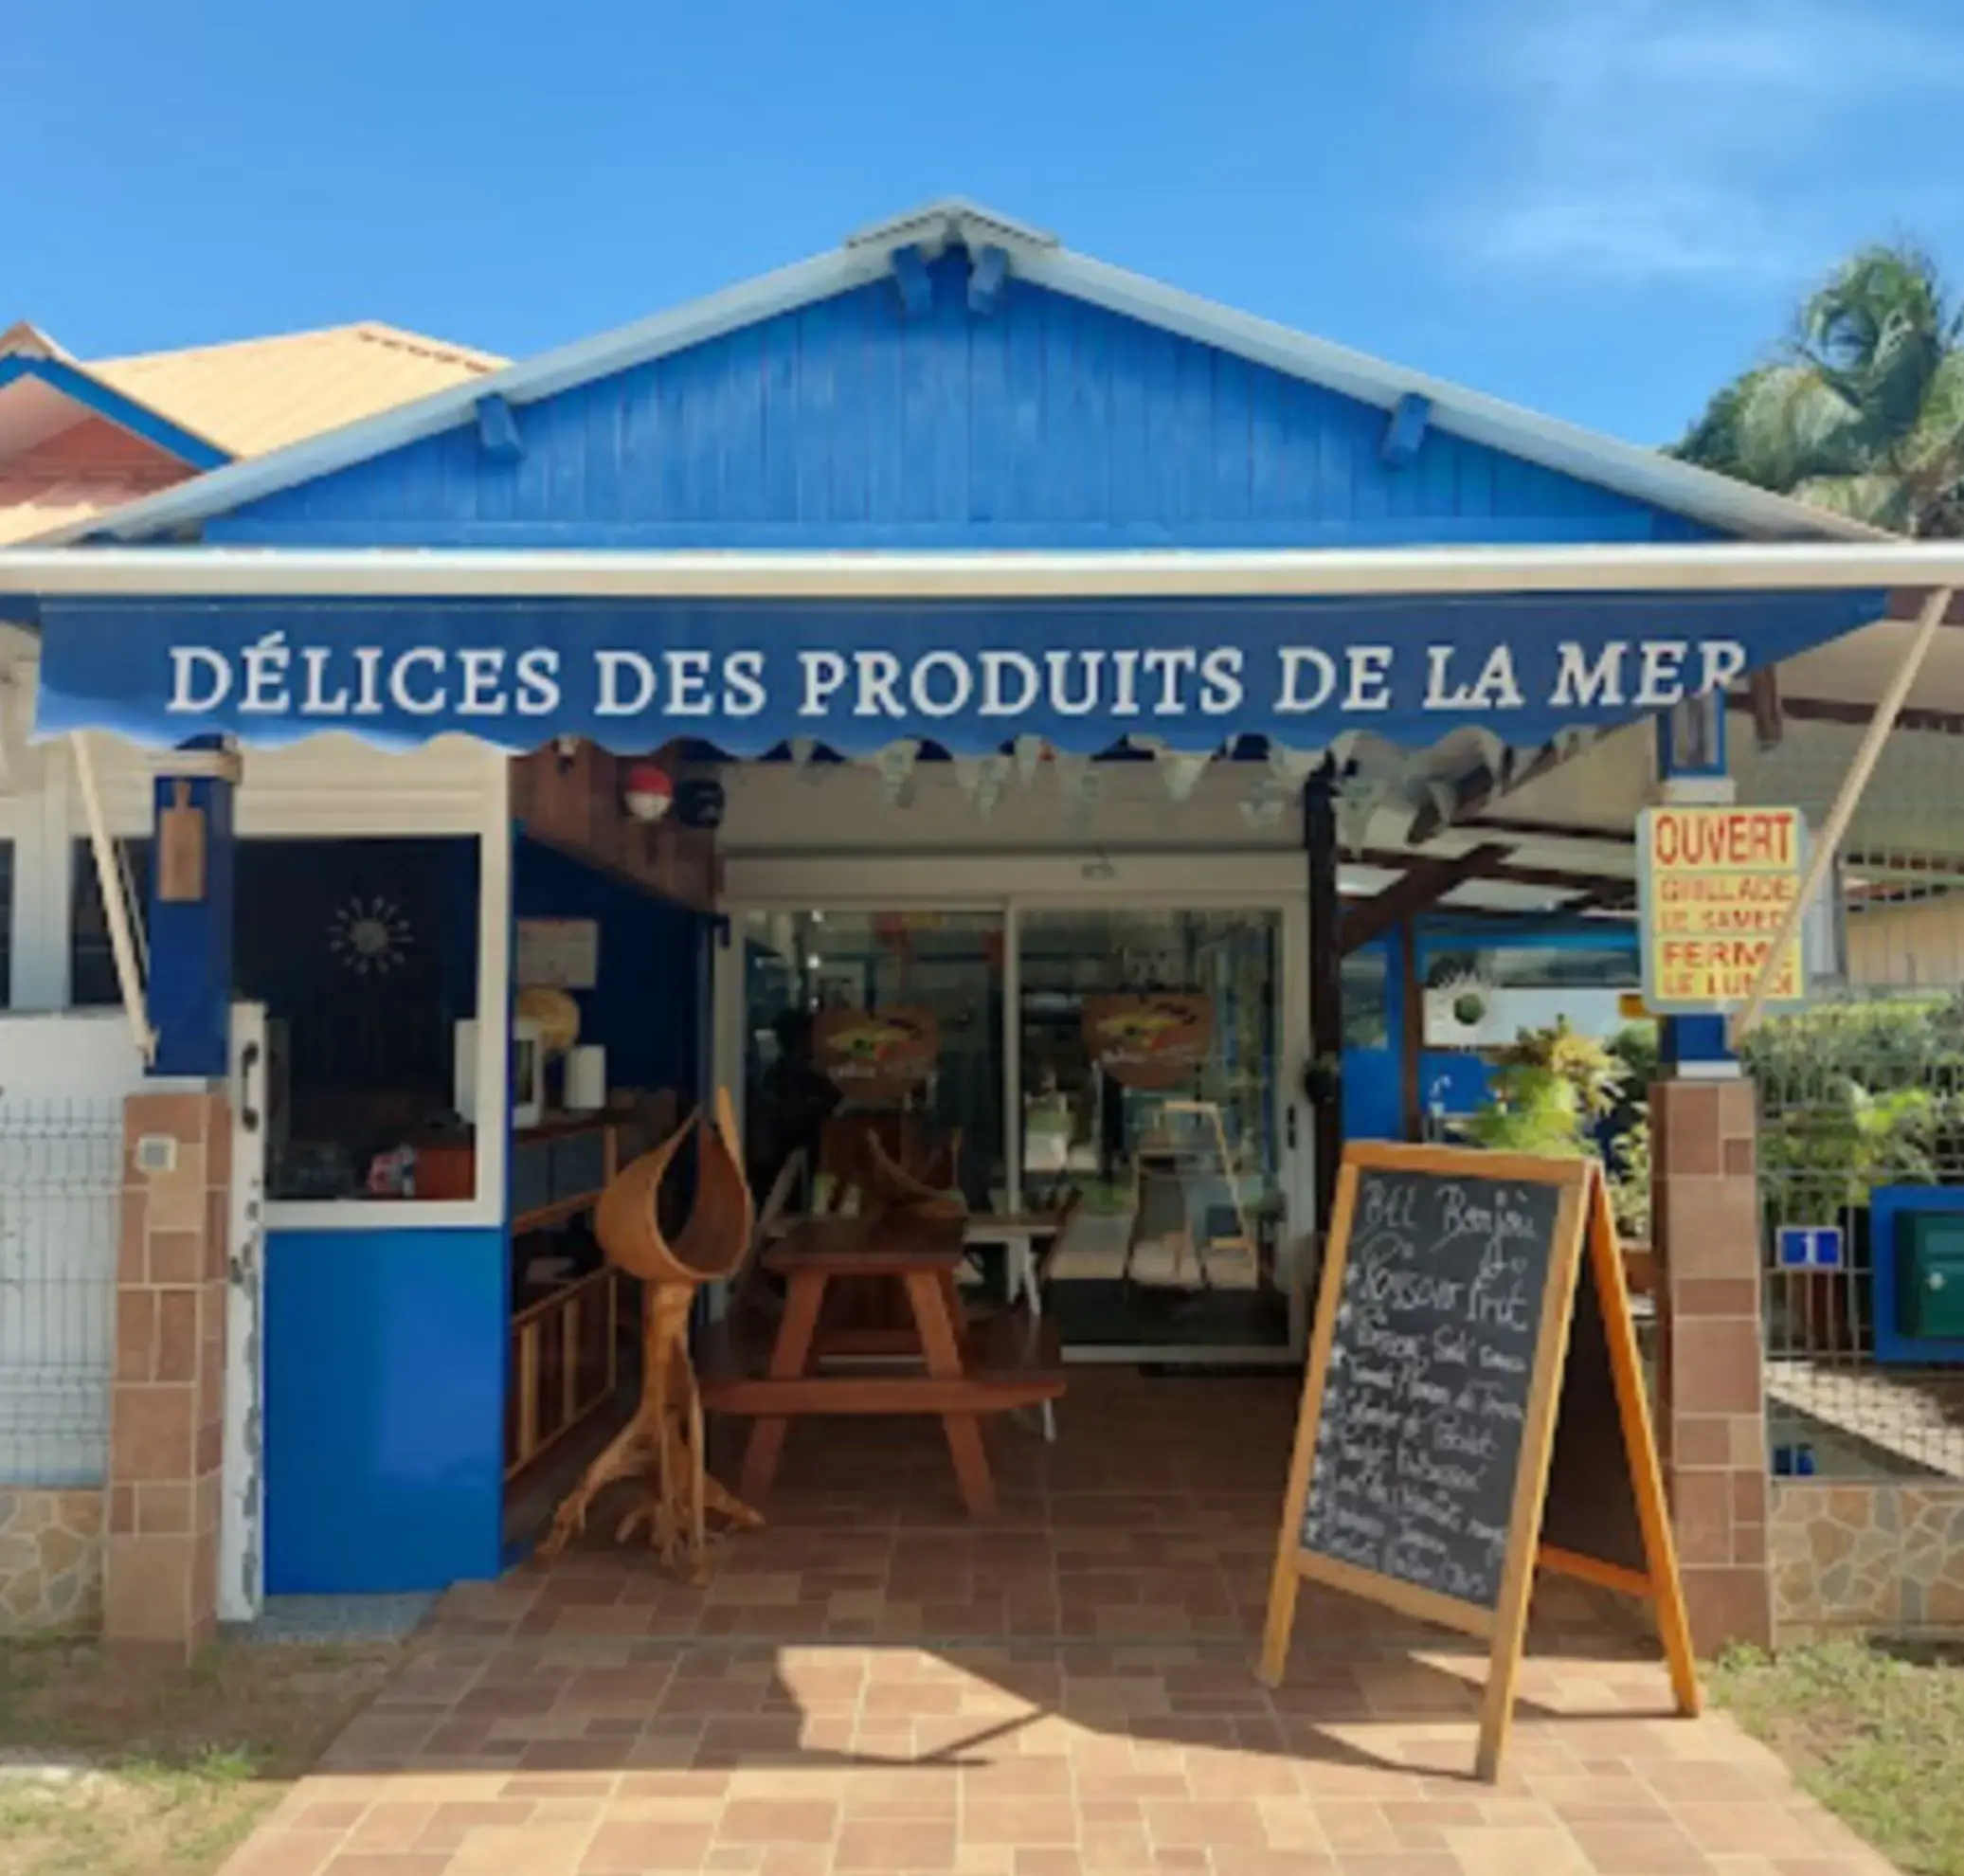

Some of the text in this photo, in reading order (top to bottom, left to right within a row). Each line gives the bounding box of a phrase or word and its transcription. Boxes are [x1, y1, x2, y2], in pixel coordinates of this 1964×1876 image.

[168, 632, 1747, 717] DÉLICES DES PRODUITS DE LA MER
[1655, 814, 1793, 866] OUVERT
